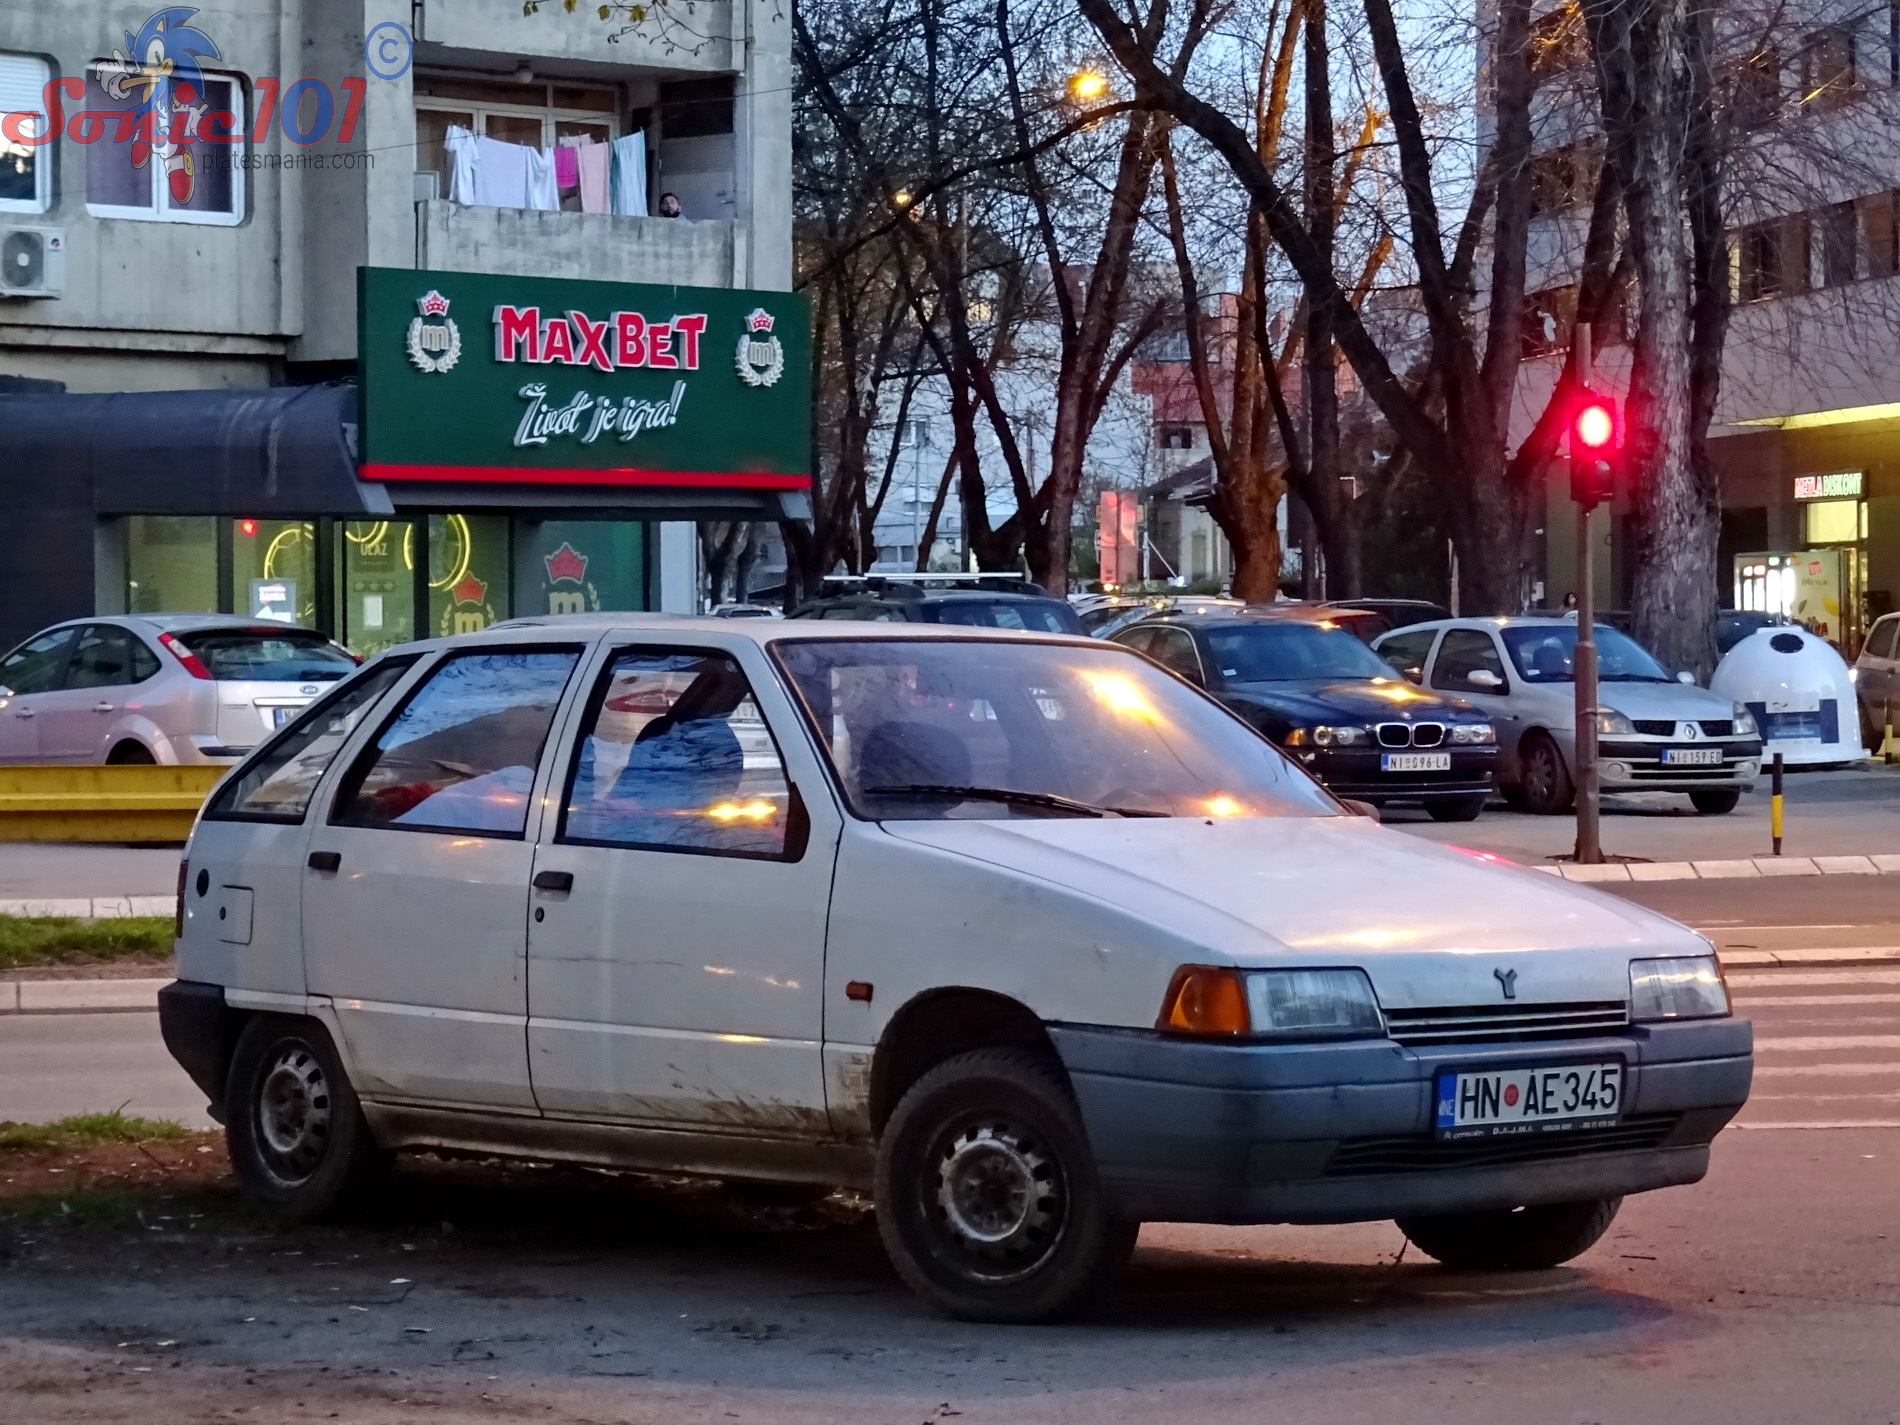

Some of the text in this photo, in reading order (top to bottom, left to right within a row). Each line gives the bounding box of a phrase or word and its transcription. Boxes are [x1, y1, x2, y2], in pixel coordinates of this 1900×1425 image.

[514, 382, 594, 446] Život
[1460, 1077, 1500, 1119] HN
[1523, 1069, 1618, 1116] AE345
